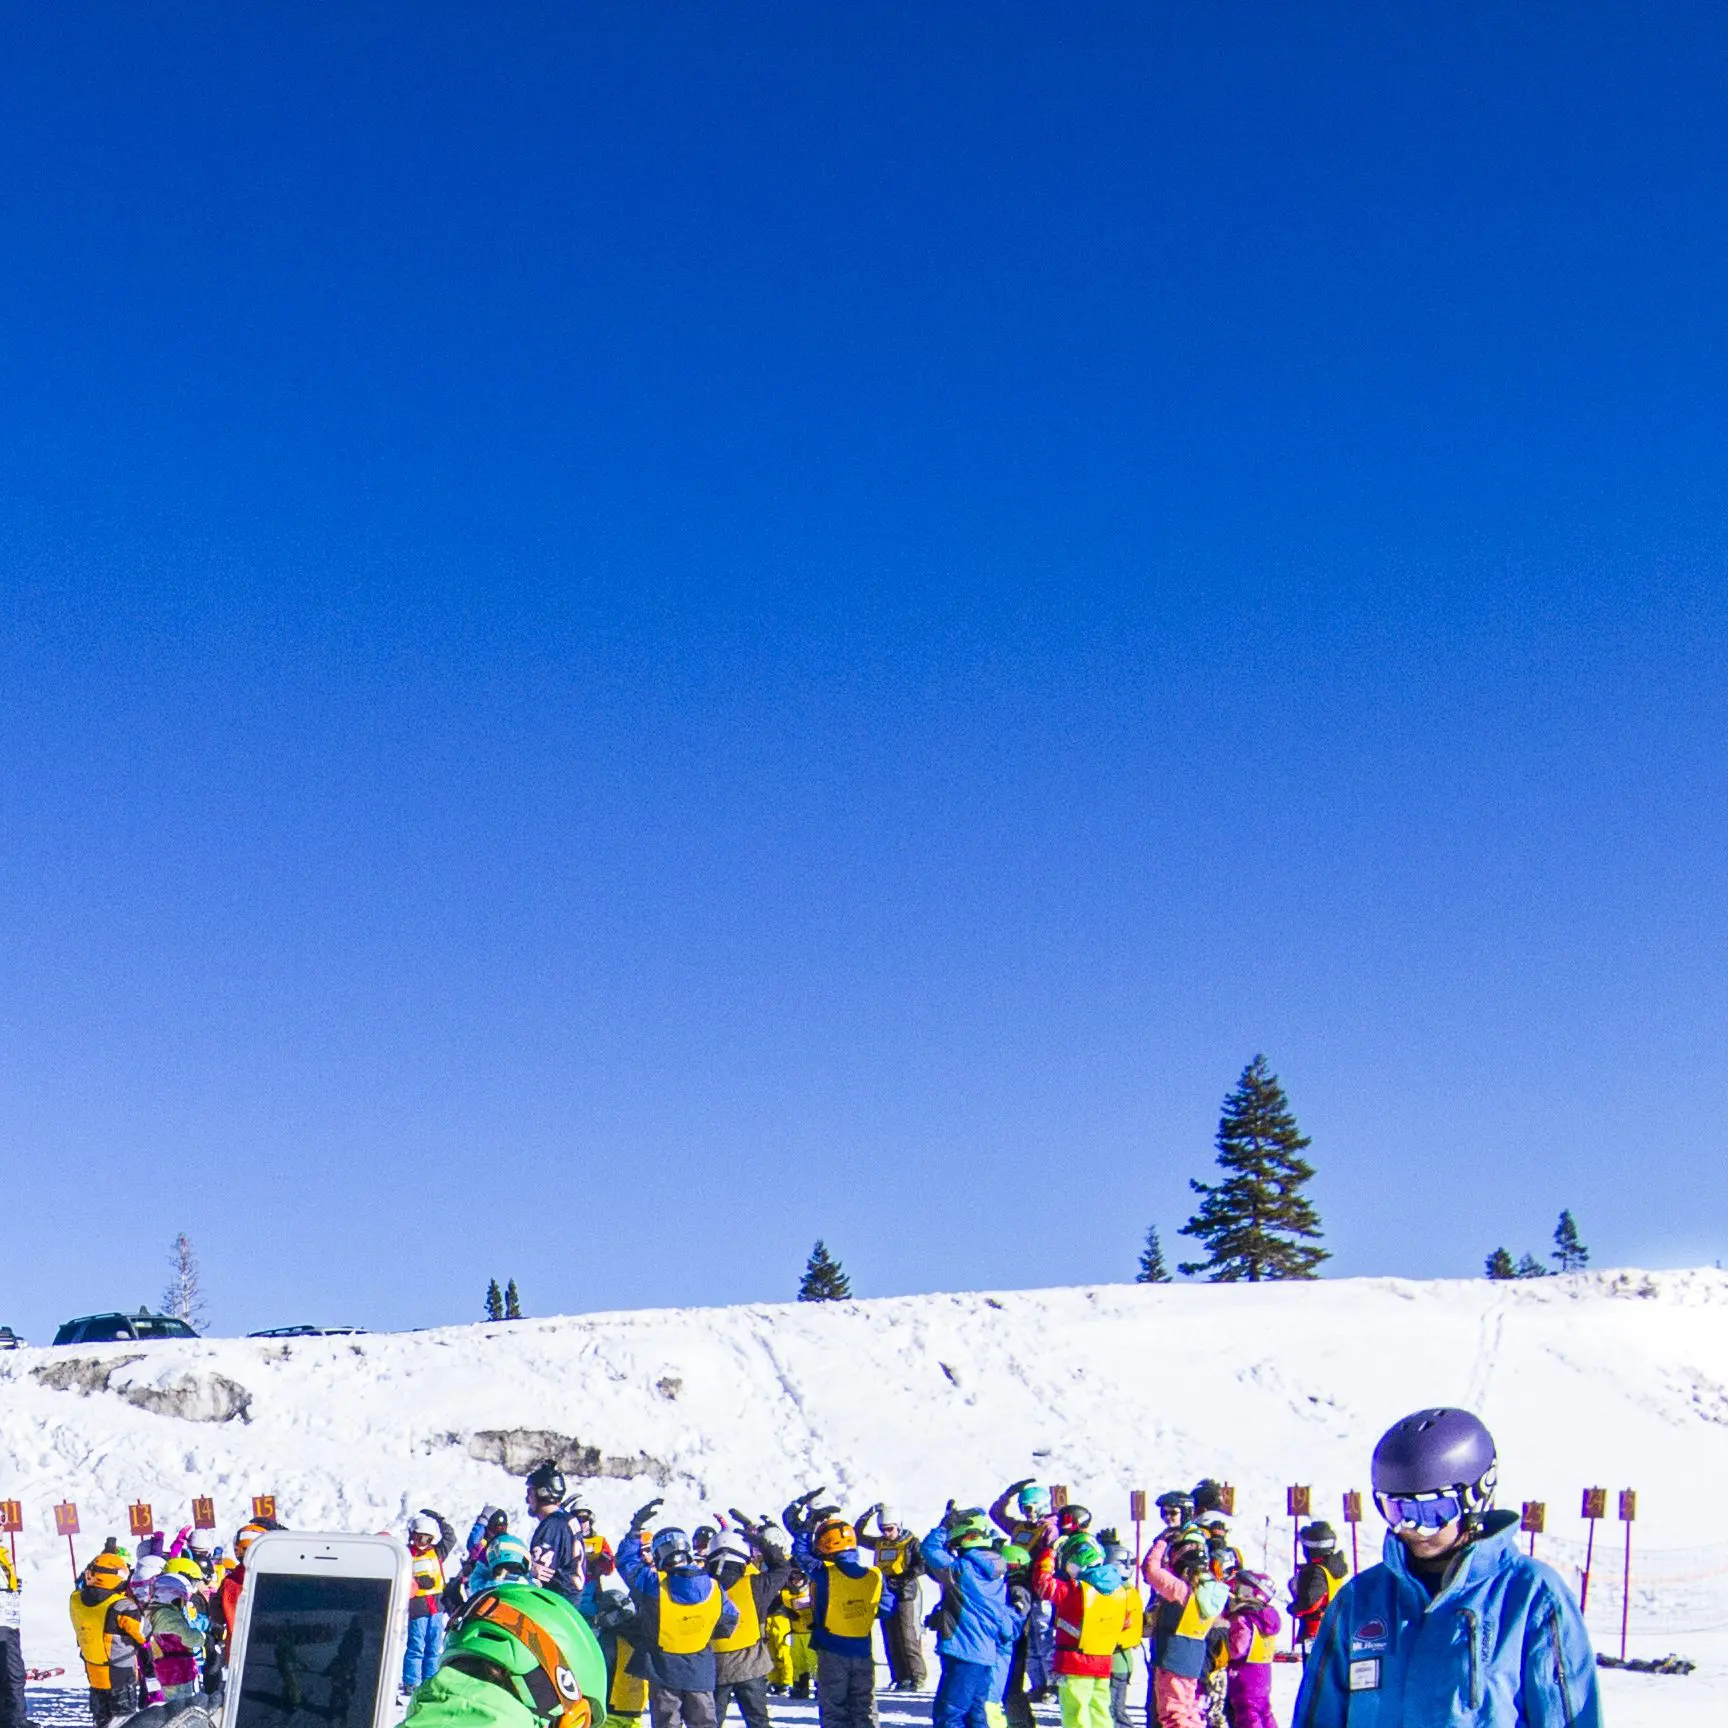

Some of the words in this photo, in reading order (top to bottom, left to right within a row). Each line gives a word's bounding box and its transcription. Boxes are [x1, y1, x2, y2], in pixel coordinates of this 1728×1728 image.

[56, 1504, 77, 1526] 12
[131, 1504, 151, 1529] 13
[193, 1499, 213, 1521] 14
[254, 1497, 274, 1518] 15
